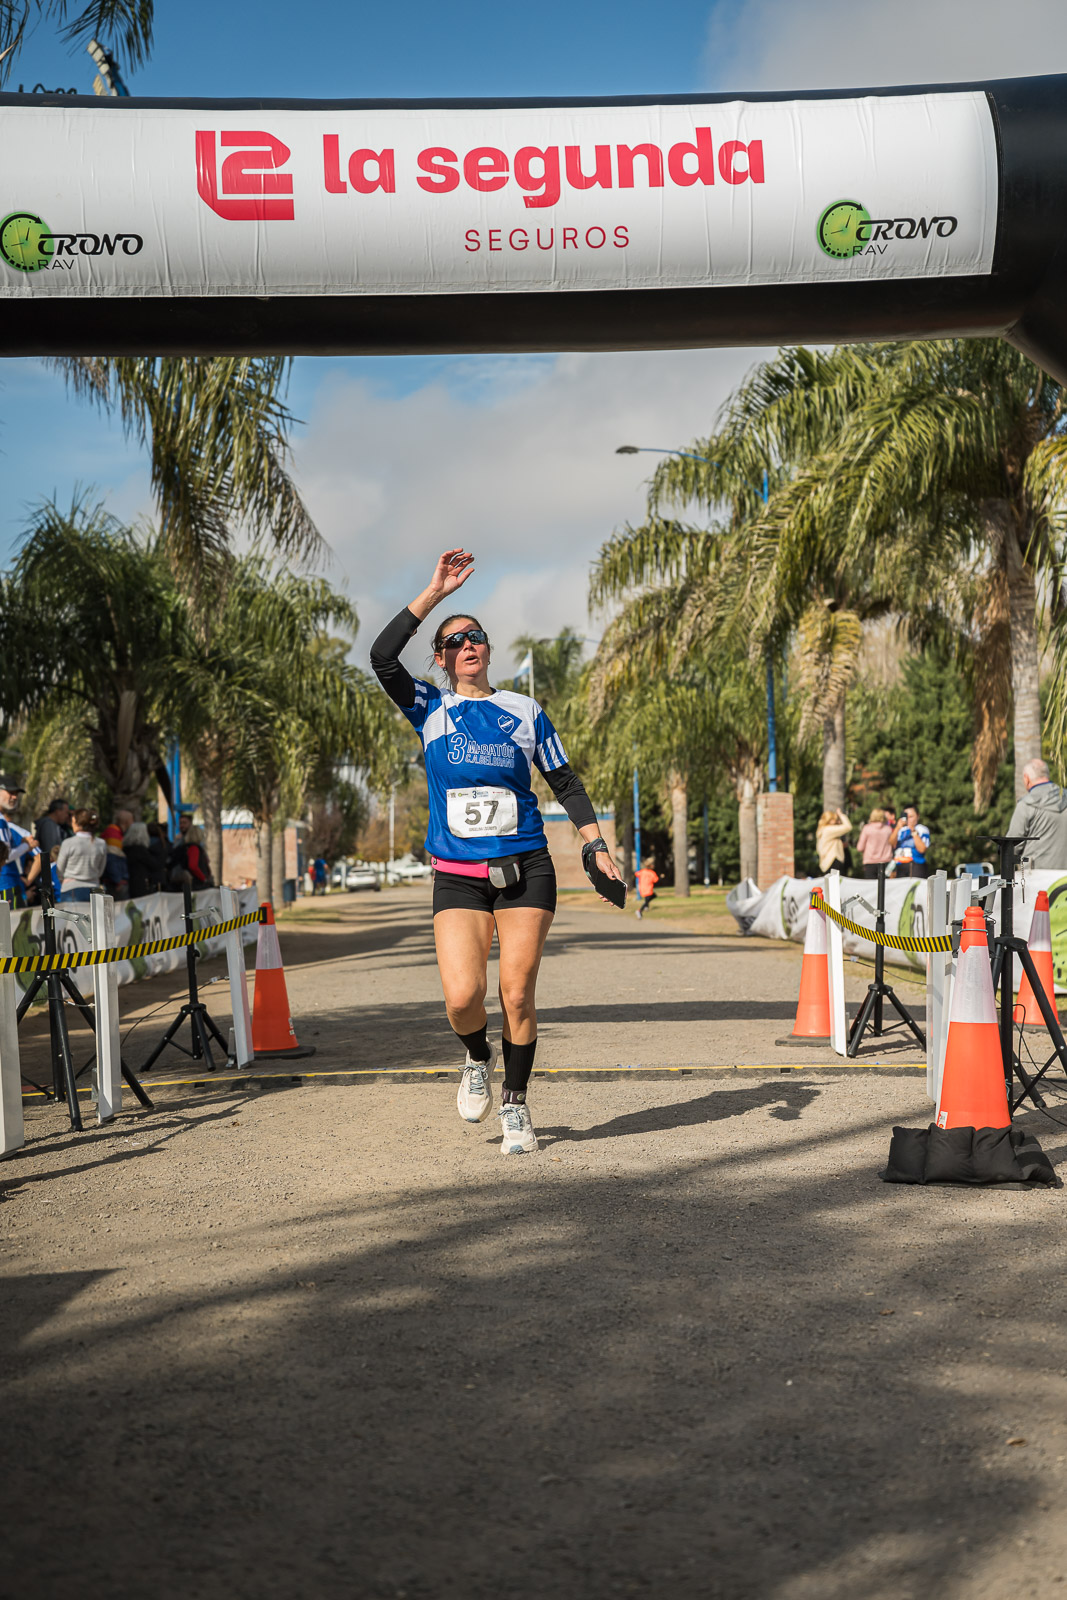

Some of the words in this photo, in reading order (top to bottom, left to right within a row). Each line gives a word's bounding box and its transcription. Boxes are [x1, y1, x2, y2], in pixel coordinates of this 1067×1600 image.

[323, 134, 396, 194] la
[416, 127, 765, 208] segunda
[464, 225, 630, 251] SEGUROS
[856, 216, 958, 241] CRONO
[37, 233, 144, 256] CRONO
[853, 243, 889, 256] RAV
[37, 259, 75, 270] RAV
[447, 732, 468, 765] 3
[472, 790, 477, 799] 3
[464, 800, 499, 826] 57
